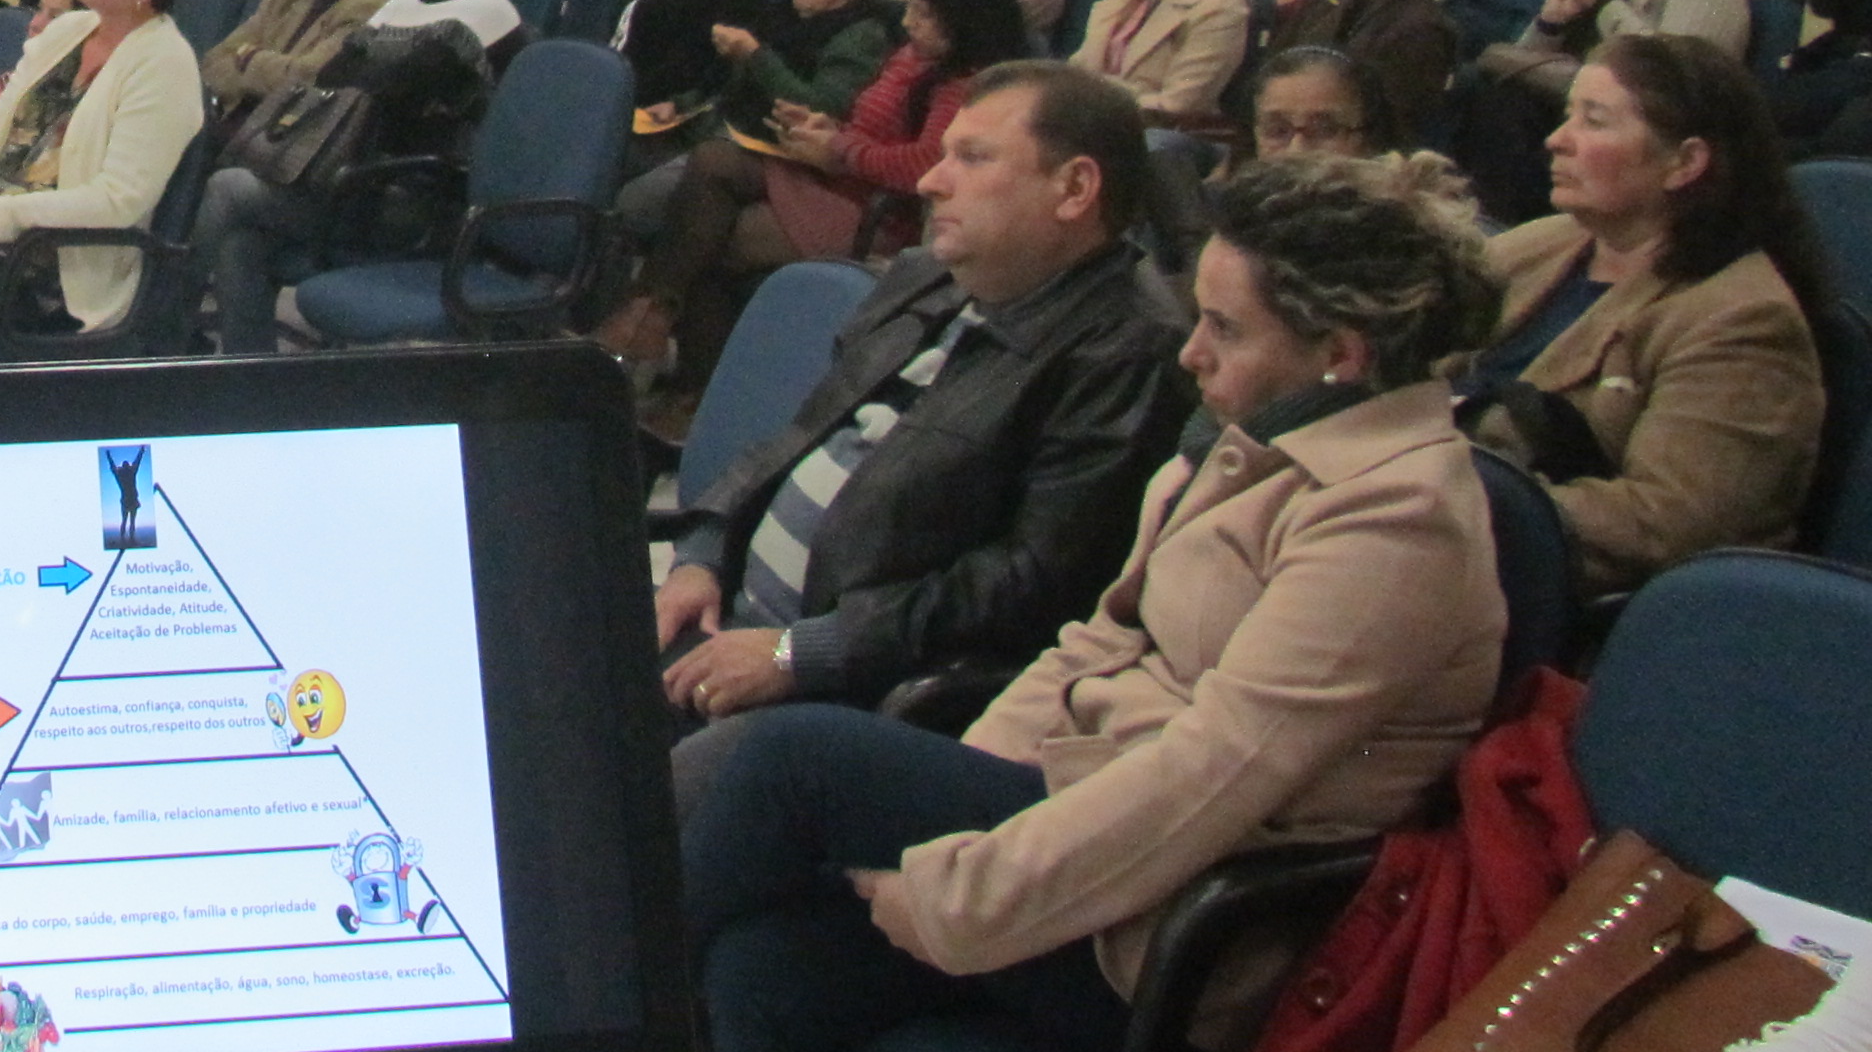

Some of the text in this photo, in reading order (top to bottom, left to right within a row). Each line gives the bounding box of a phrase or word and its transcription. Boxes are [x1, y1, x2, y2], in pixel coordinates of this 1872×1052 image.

[126, 560, 193, 575] Motivação,
[110, 580, 212, 597] Espontaneidade,
[98, 600, 227, 618] Criatividade, Atitude,
[90, 622, 237, 641] Aceitação de Problemas
[49, 696, 248, 717] Autoestima, confiança, conquista,
[34, 726, 84, 739] respeito
[87, 725, 107, 736] aos
[204, 716, 225, 729] dos
[228, 715, 266, 727] outros
[53, 812, 110, 827] Amizade,
[113, 809, 161, 824] família,
[164, 804, 261, 821] relacionamento
[265, 800, 308, 815] afetivo
[311, 802, 319, 812] e
[13, 917, 28, 930] do
[32, 916, 71, 930] corpo,
[75, 911, 116, 926] saúde,
[120, 909, 179, 924] emprego,
[183, 904, 226, 919] família
[231, 905, 238, 916] e
[242, 899, 317, 918] propriedade
[74, 962, 455, 1000] Respiração, alimentação, água, sono, homeostase, excreção.
